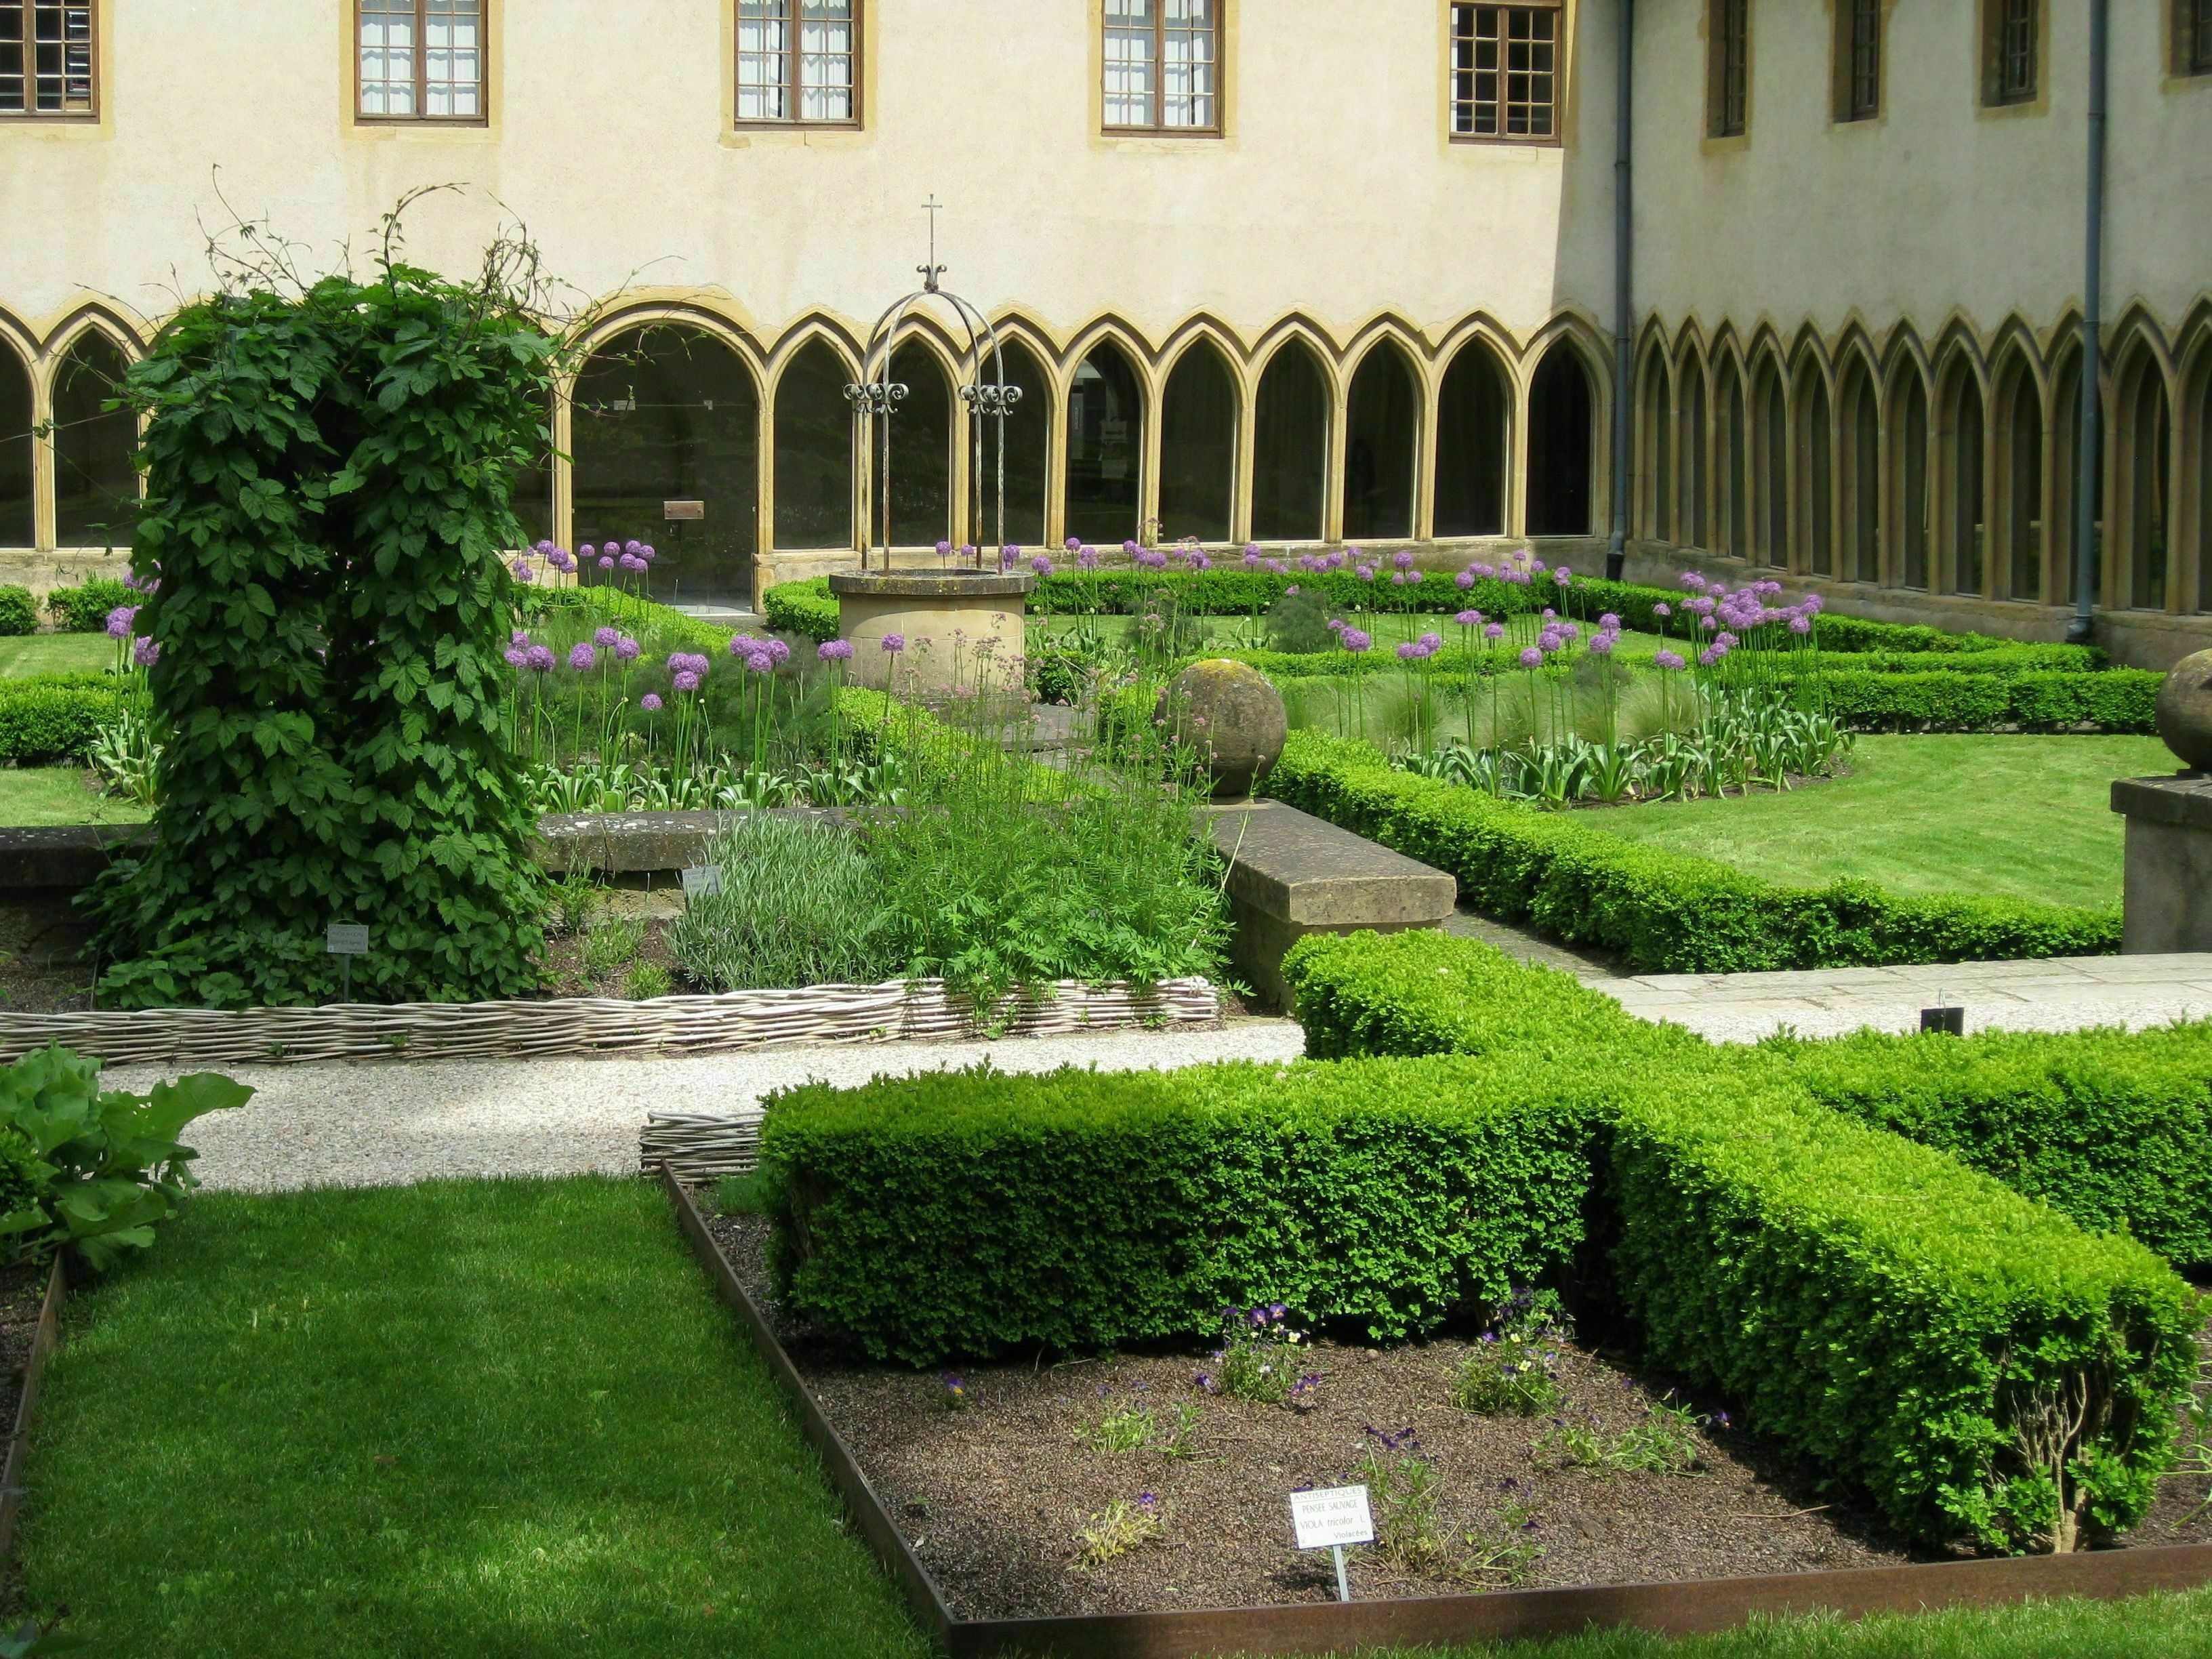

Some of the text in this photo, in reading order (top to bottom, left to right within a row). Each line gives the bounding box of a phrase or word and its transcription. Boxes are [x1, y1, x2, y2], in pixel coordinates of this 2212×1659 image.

[1293, 1487, 1362, 1501] ANTISEPTIQUES
[1302, 1499, 1357, 1514] PENSEE SAUVAGE
[1300, 1519, 1324, 1530] VIOLA
[1328, 1515, 1353, 1527] tricolor
[1334, 1530, 1368, 1539] Violacées
